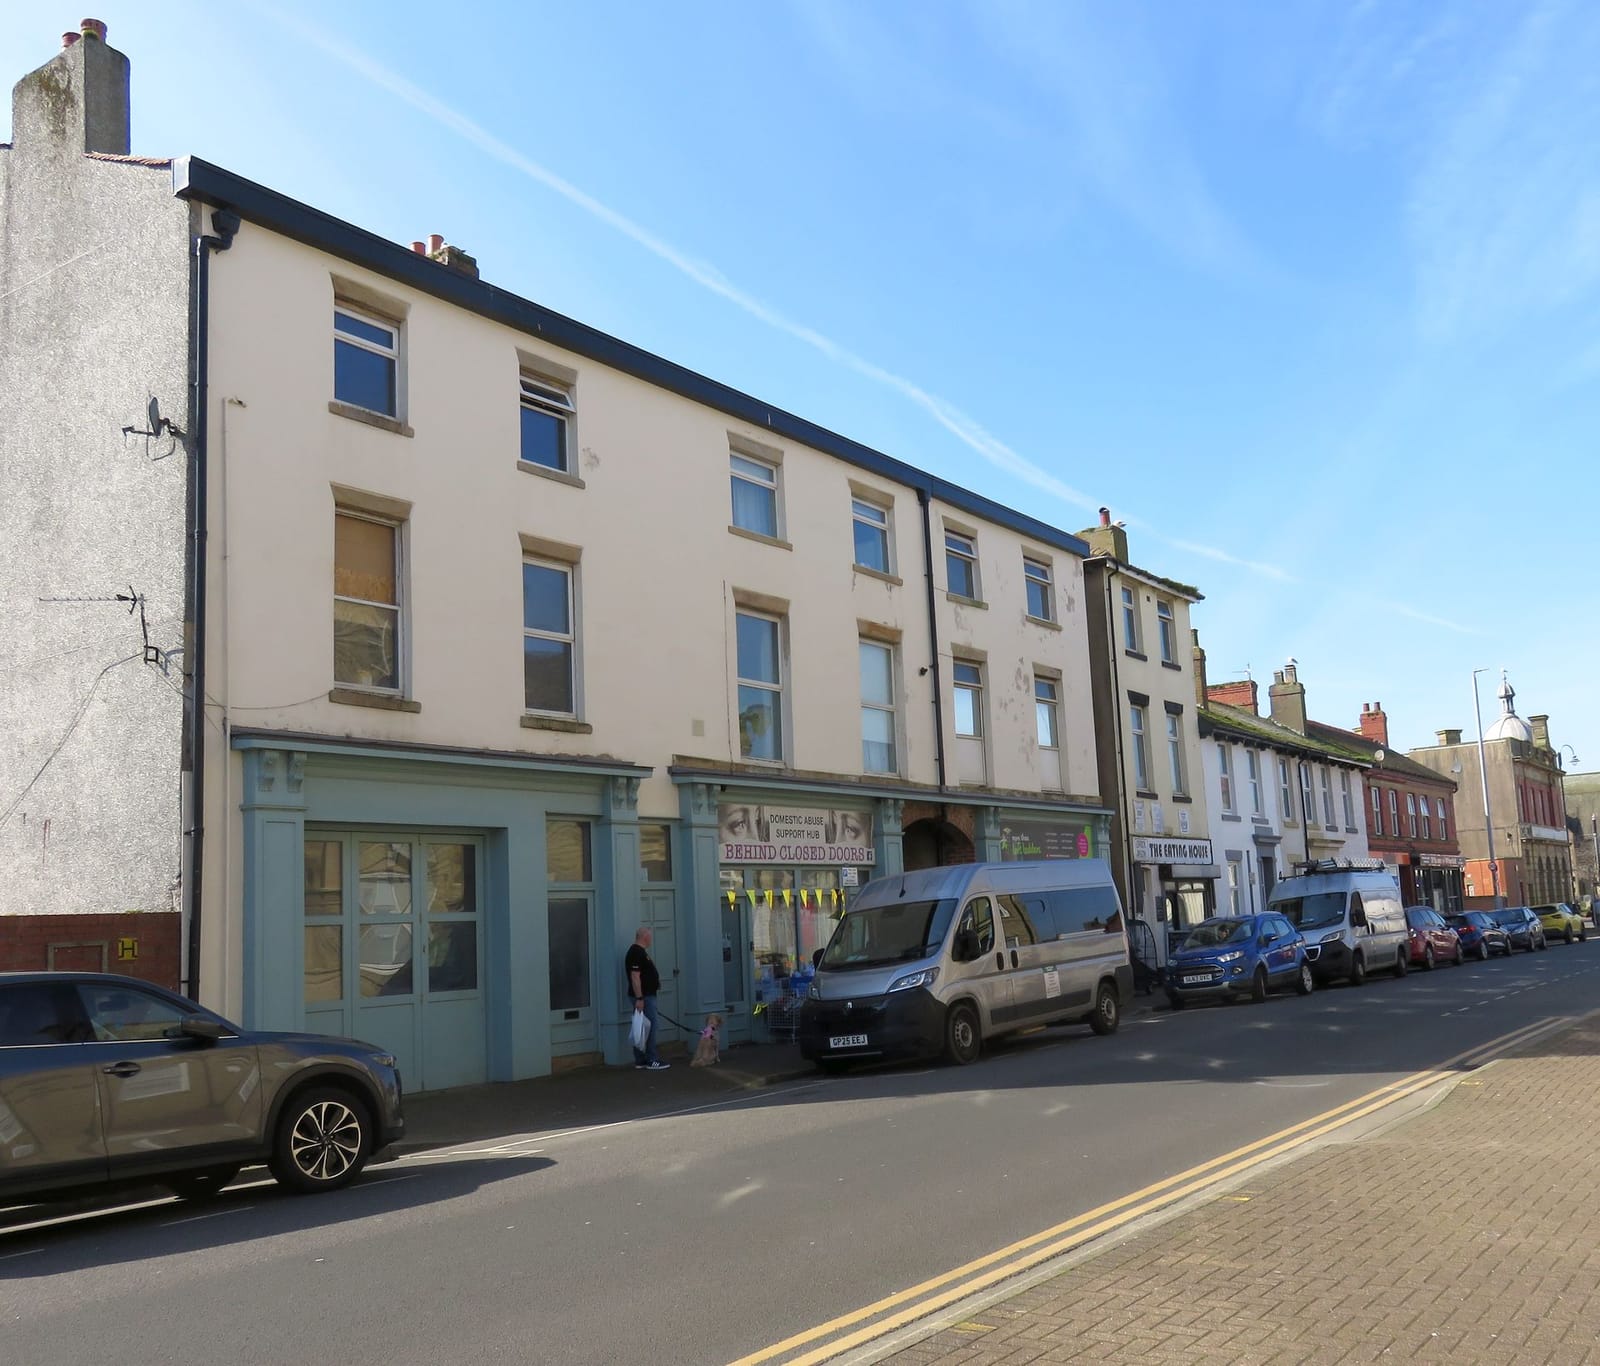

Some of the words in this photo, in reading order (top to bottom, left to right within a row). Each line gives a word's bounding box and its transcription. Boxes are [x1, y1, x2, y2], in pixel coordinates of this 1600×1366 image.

[769, 814, 803, 825] DOMESTIC
[804, 816, 824, 826] ABUSE
[775, 829, 806, 839] SUPPORT
[807, 830, 820, 839] HUB
[725, 843, 777, 860] BEHIND
[779, 845, 826, 861] CLOSED
[829, 847, 865, 862] DOORS
[1149, 843, 1162, 858] THE
[1163, 844, 1188, 858] EATING
[1188, 844, 1208, 859] HOUSE
